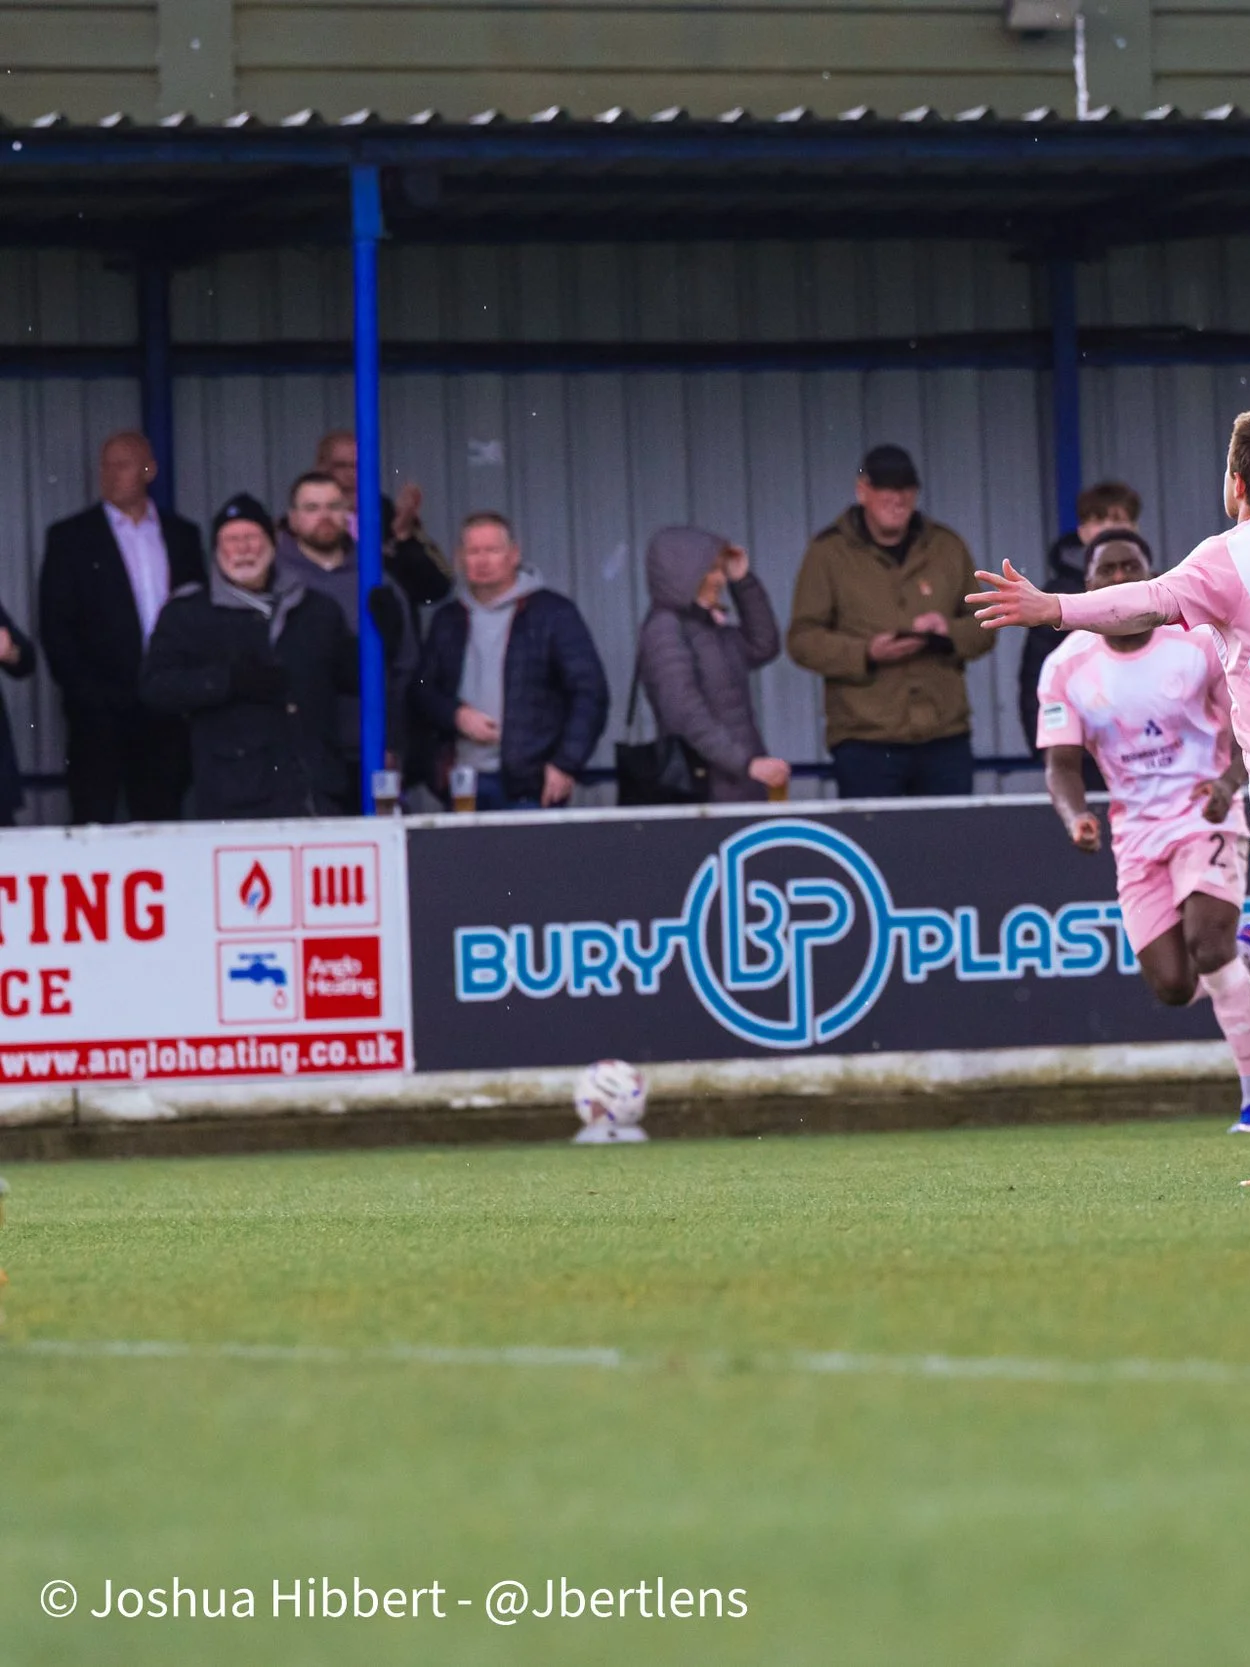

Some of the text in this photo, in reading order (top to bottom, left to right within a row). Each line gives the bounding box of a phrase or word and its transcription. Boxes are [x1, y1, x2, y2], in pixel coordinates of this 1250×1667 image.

[308, 955, 363, 977] Anglo
[455, 918, 682, 1002] BURY
[305, 977, 377, 1000] Heating
[0, 1031, 398, 1081] www.angloheating.co.uk
